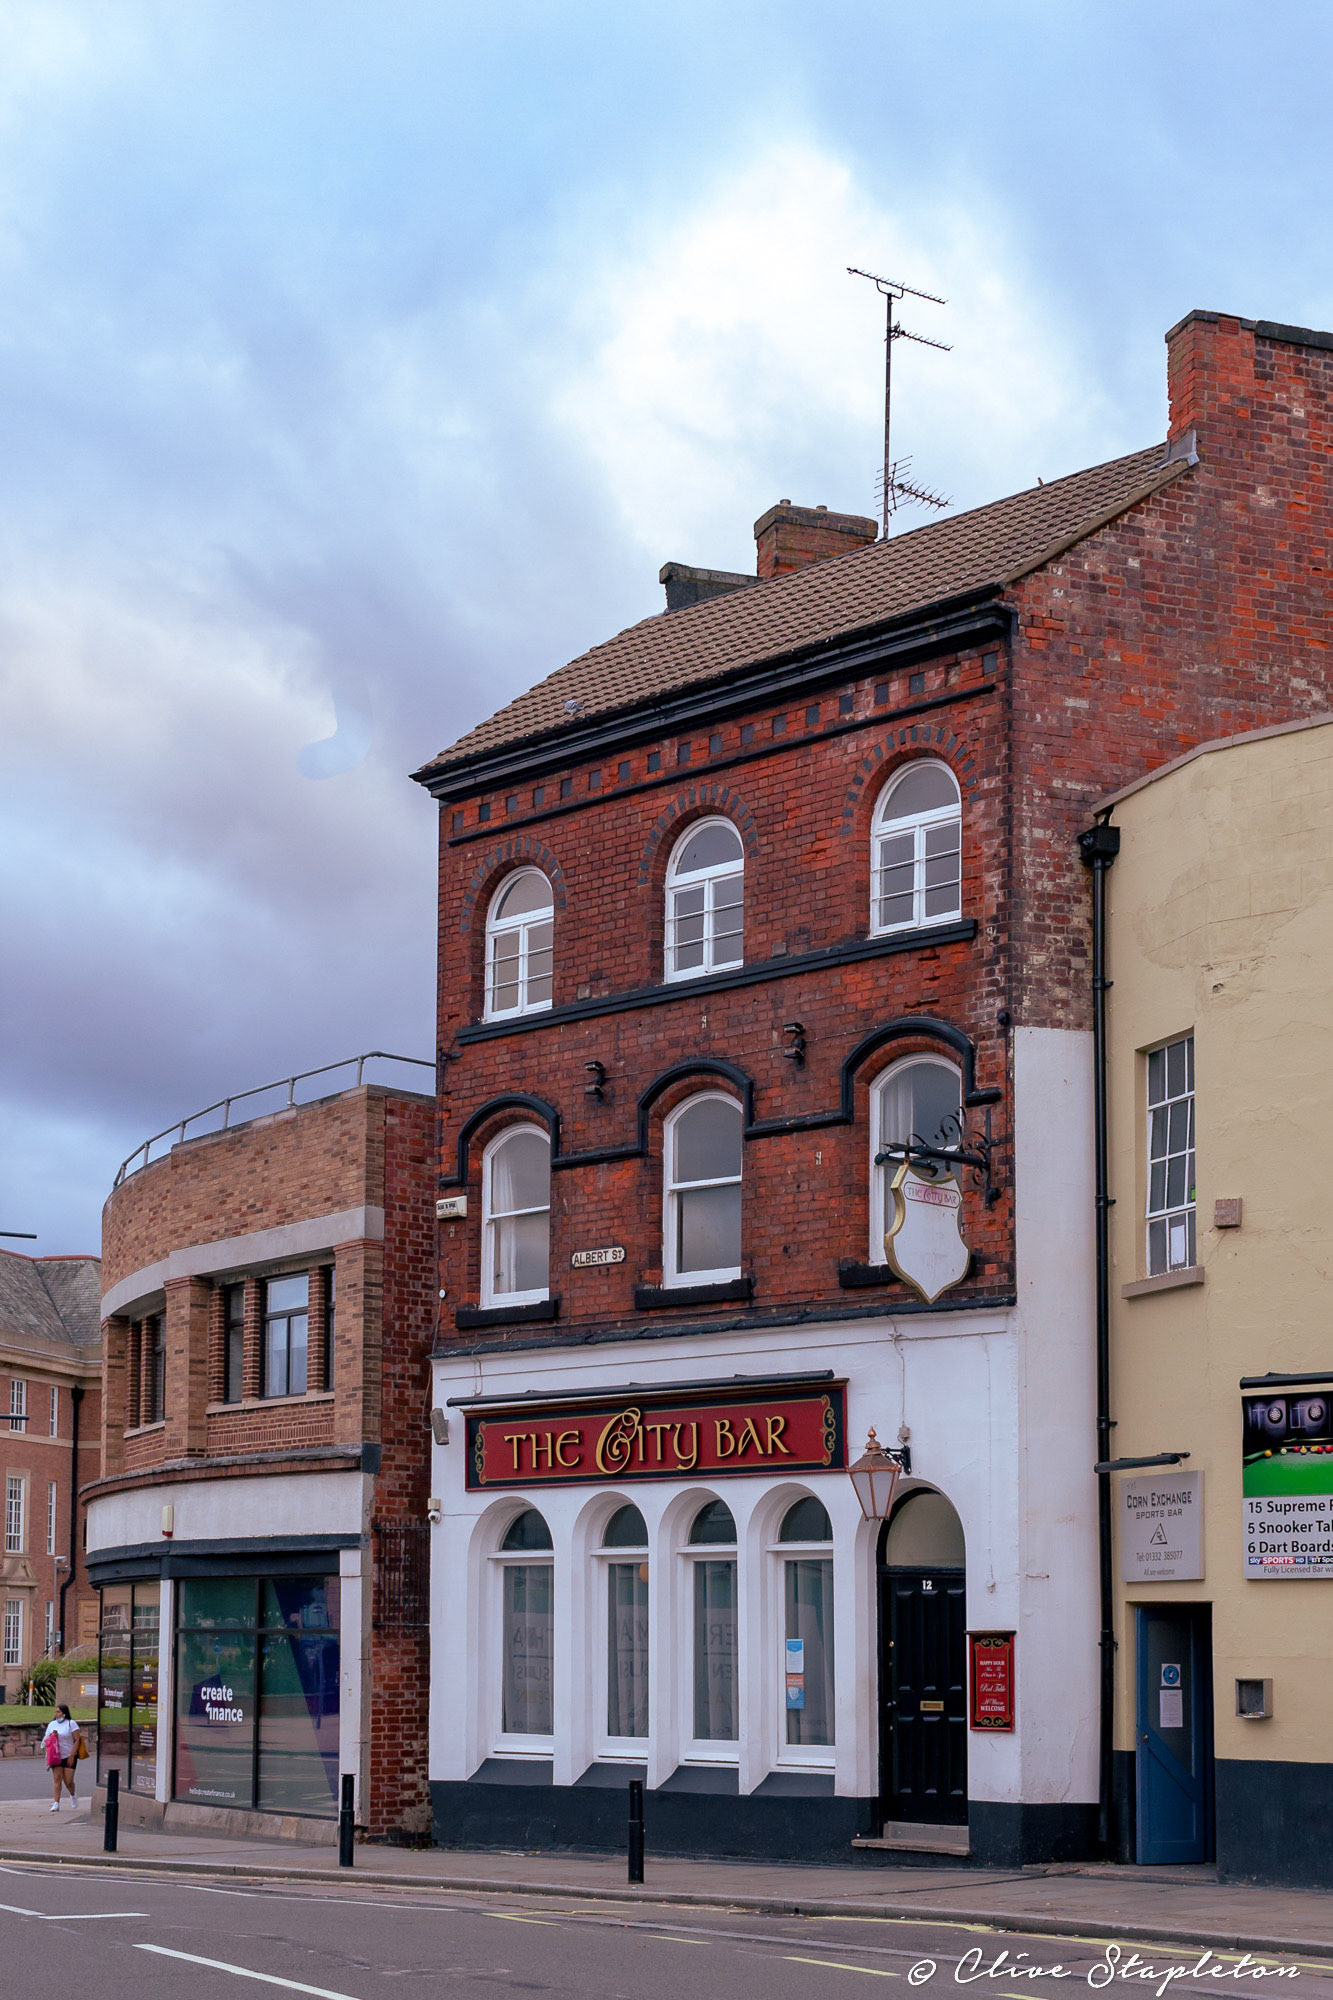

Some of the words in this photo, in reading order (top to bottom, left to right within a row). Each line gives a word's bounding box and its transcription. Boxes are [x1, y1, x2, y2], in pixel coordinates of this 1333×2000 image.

[573, 1251, 608, 1265] ALBERT
[504, 1430, 580, 1470] THE
[714, 1416, 791, 1458] BAR
[1127, 1494, 1148, 1508] CORN
[1151, 1491, 1192, 1507] EXCHANGE
[1136, 1509, 1165, 1519] SPORTS
[1167, 1508, 1183, 1517] BAR
[1248, 1502, 1262, 1513] 15
[1267, 1500, 1326, 1515] Supreme
[1248, 1522, 1255, 1534] 5
[1259, 1520, 1313, 1533] Snooker
[1248, 1542, 1256, 1553] 6
[1259, 1541, 1288, 1553] Dart
[1249, 1556, 1261, 1564] sky
[1262, 1556, 1294, 1564] SPORTS
[1264, 1566, 1280, 1574] Fully
[1281, 1566, 1310, 1574] Licensed
[922, 1580, 932, 1590] 12
[201, 1685, 233, 1701] create
